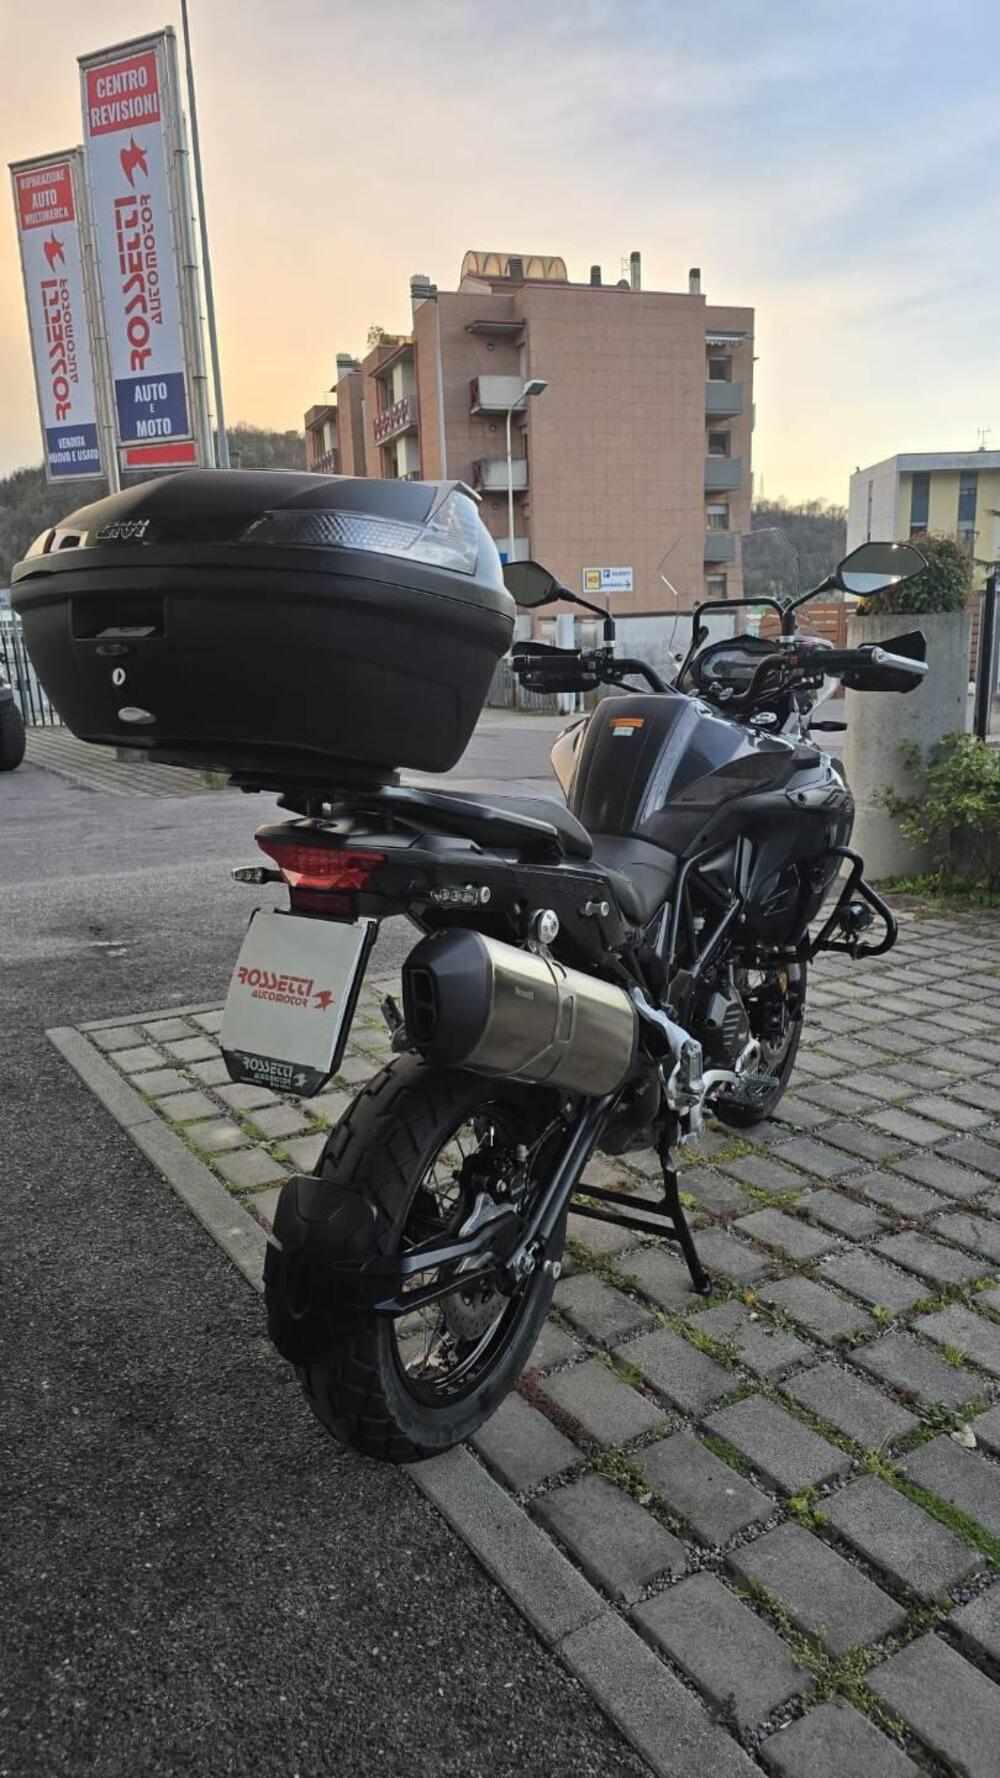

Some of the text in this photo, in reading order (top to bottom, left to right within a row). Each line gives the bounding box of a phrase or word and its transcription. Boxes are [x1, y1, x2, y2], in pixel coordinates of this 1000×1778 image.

[96, 66, 148, 98] CENTRO
[90, 93, 158, 128] REVISIONI
[32, 188, 58, 209] AUTO
[140, 193, 163, 325] AUTOMOTOR
[114, 195, 152, 371] ROSSETTI
[41, 278, 71, 421] ROSSETTI
[134, 382, 168, 403] AUTO
[150, 404, 155, 413] E
[136, 418, 172, 437] MOTO
[58, 436, 85, 449] VENDITA
[49, 448, 99, 463] NUOVO E USATO
[238, 966, 314, 996] ROSSETTI
[251, 990, 309, 1007] AUTOMOTOR
[242, 1056, 293, 1078] ROSSETTI
